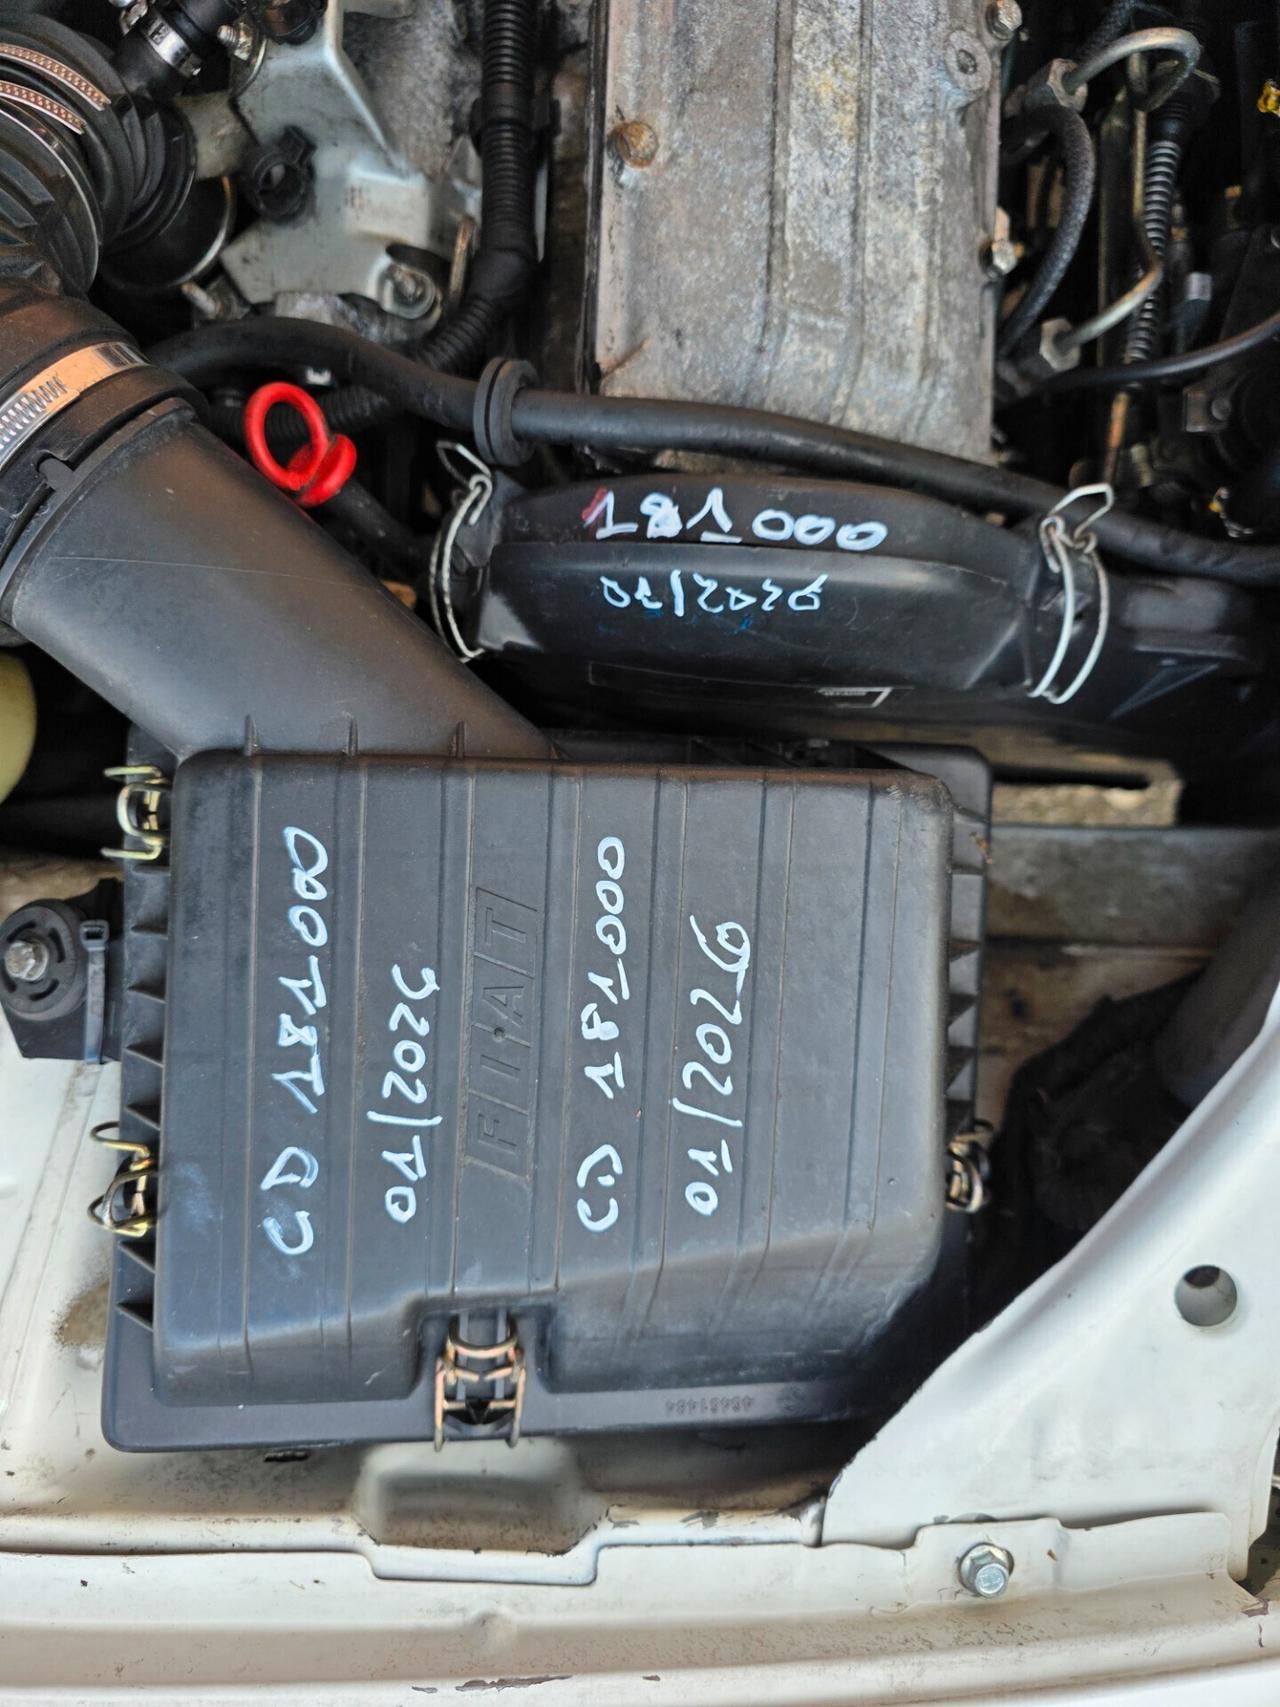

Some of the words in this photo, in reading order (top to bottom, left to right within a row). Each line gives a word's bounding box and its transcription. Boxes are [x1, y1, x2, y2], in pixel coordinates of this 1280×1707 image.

[476, 904, 530, 1158] FIAT
[670, 912, 753, 1217] 01/2026
[260, 1145, 320, 1257] CD
[575, 1143, 624, 1234] CD
